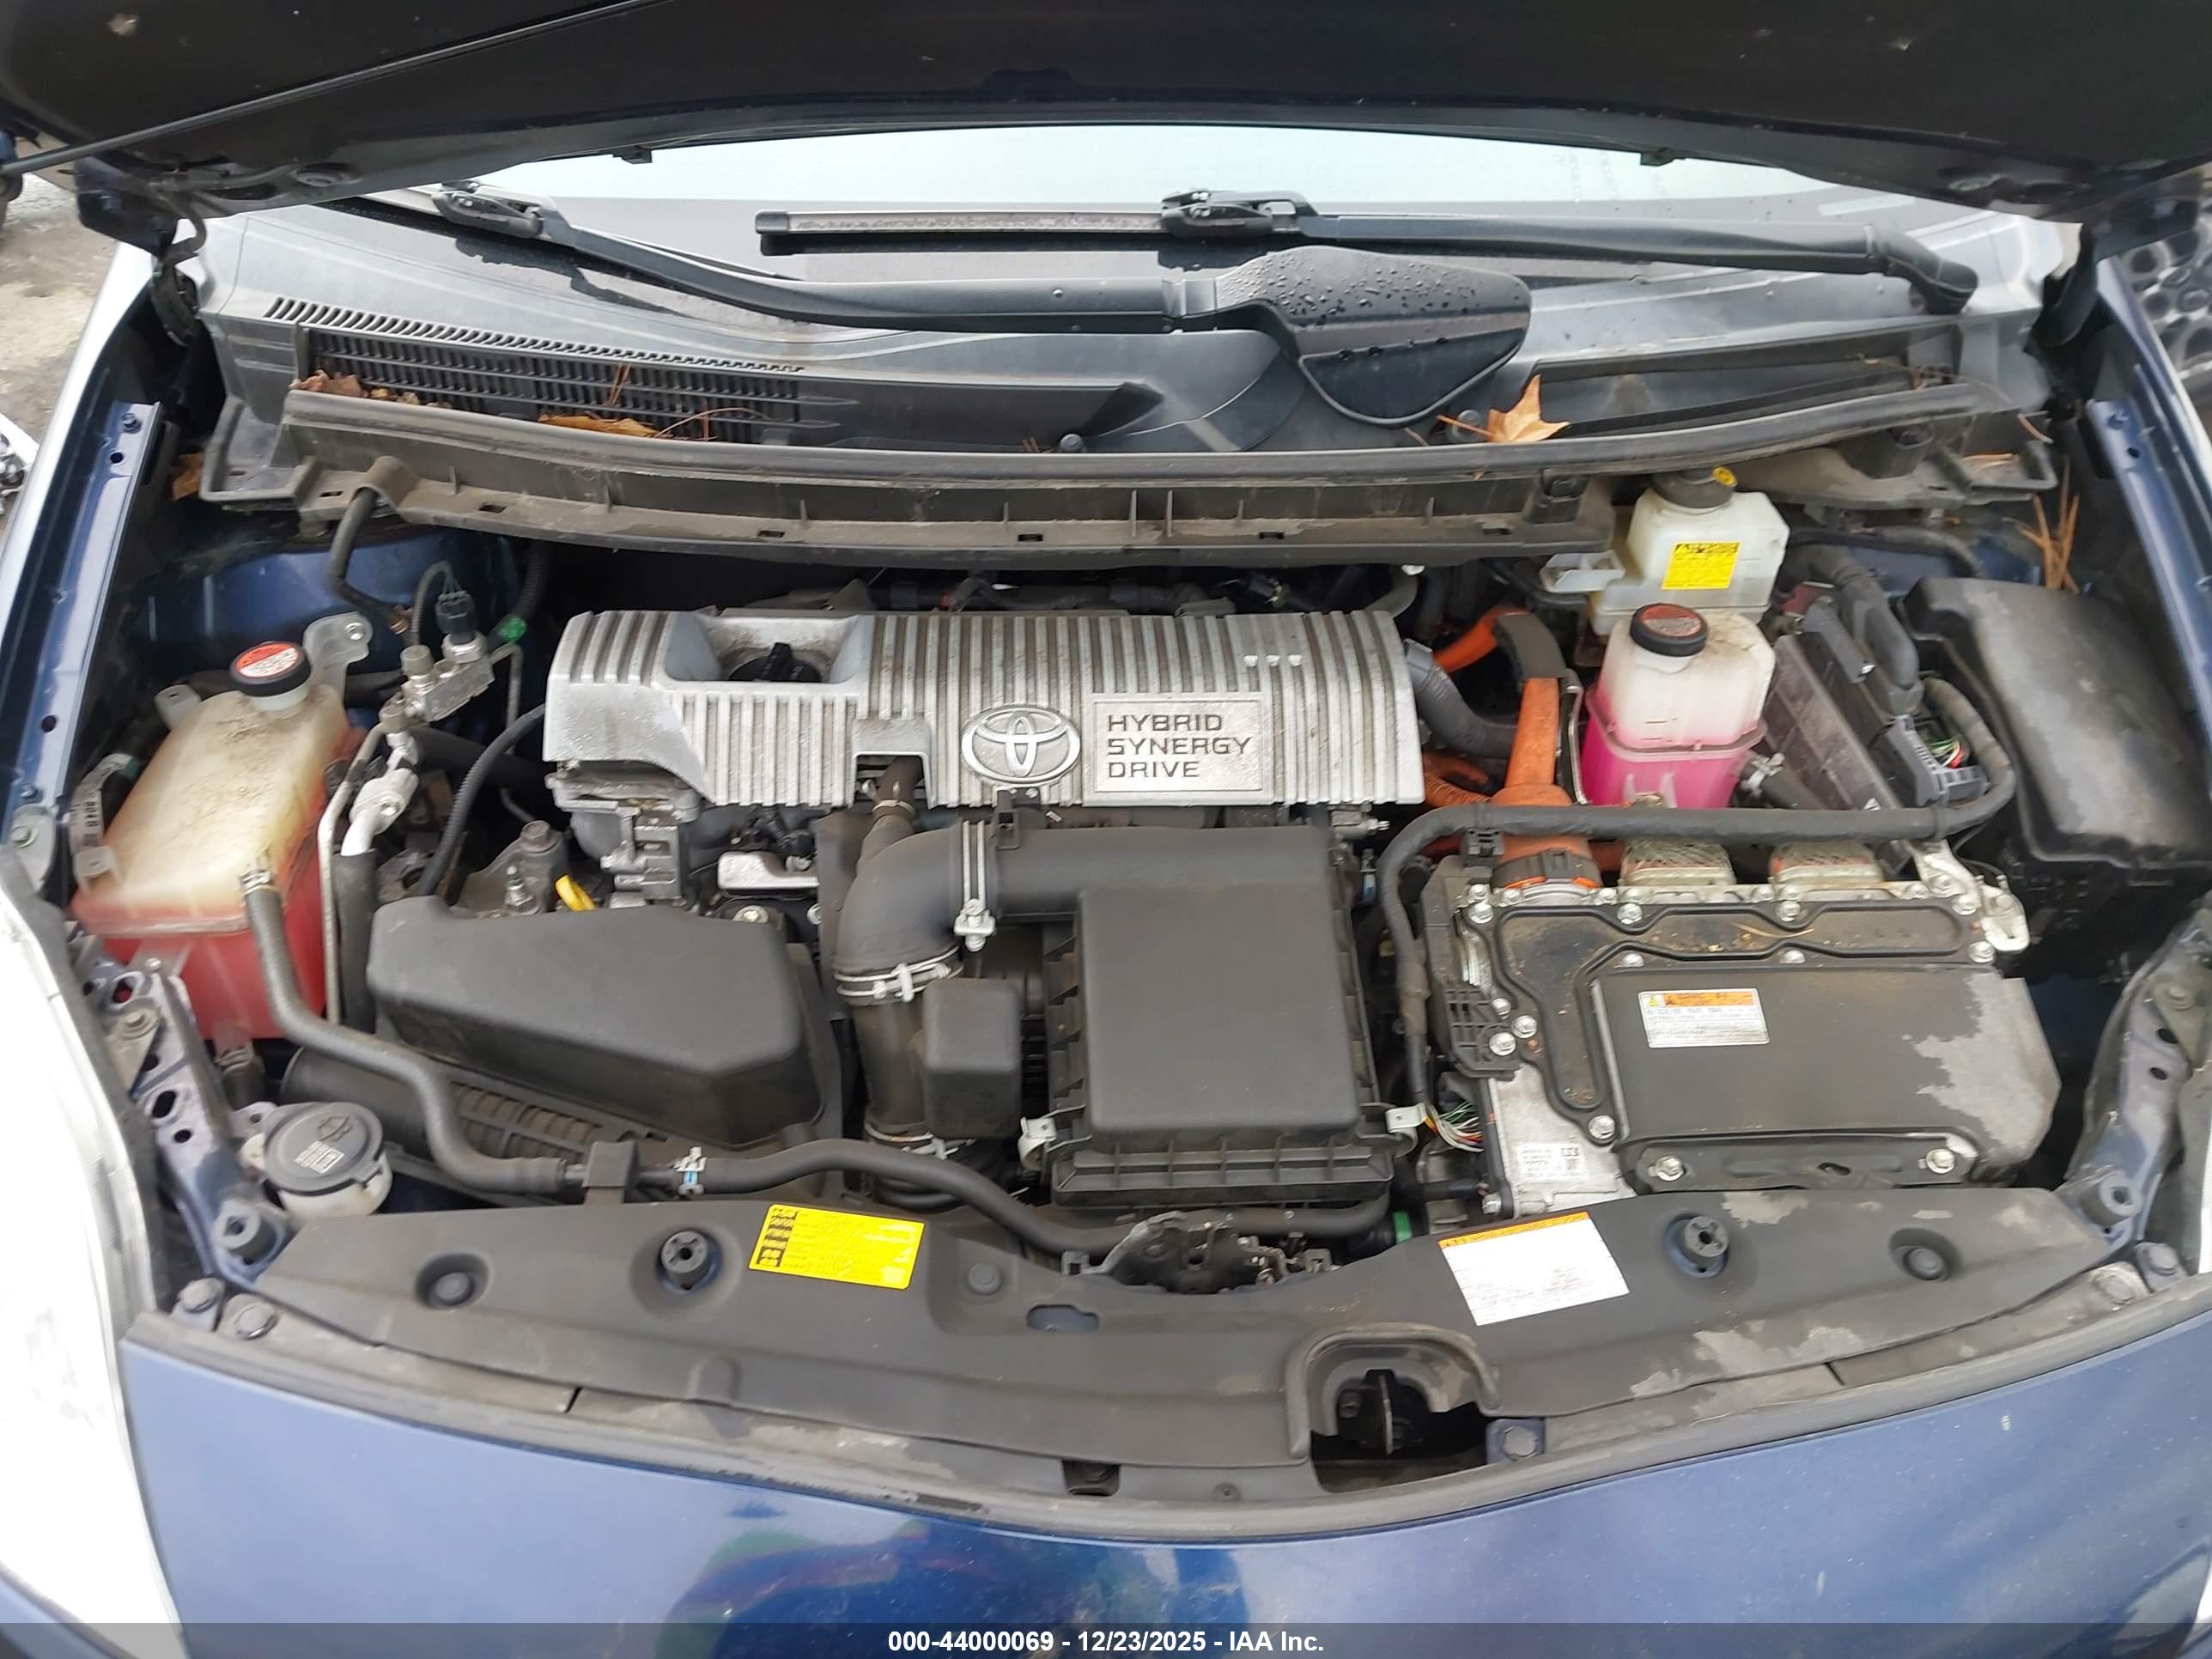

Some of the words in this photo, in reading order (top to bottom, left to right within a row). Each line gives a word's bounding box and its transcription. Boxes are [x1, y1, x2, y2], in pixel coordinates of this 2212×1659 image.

[1108, 714, 1223, 732] HYBRID
[1107, 737, 1253, 756] SYNERGY
[1108, 761, 1200, 778] DRIVE
